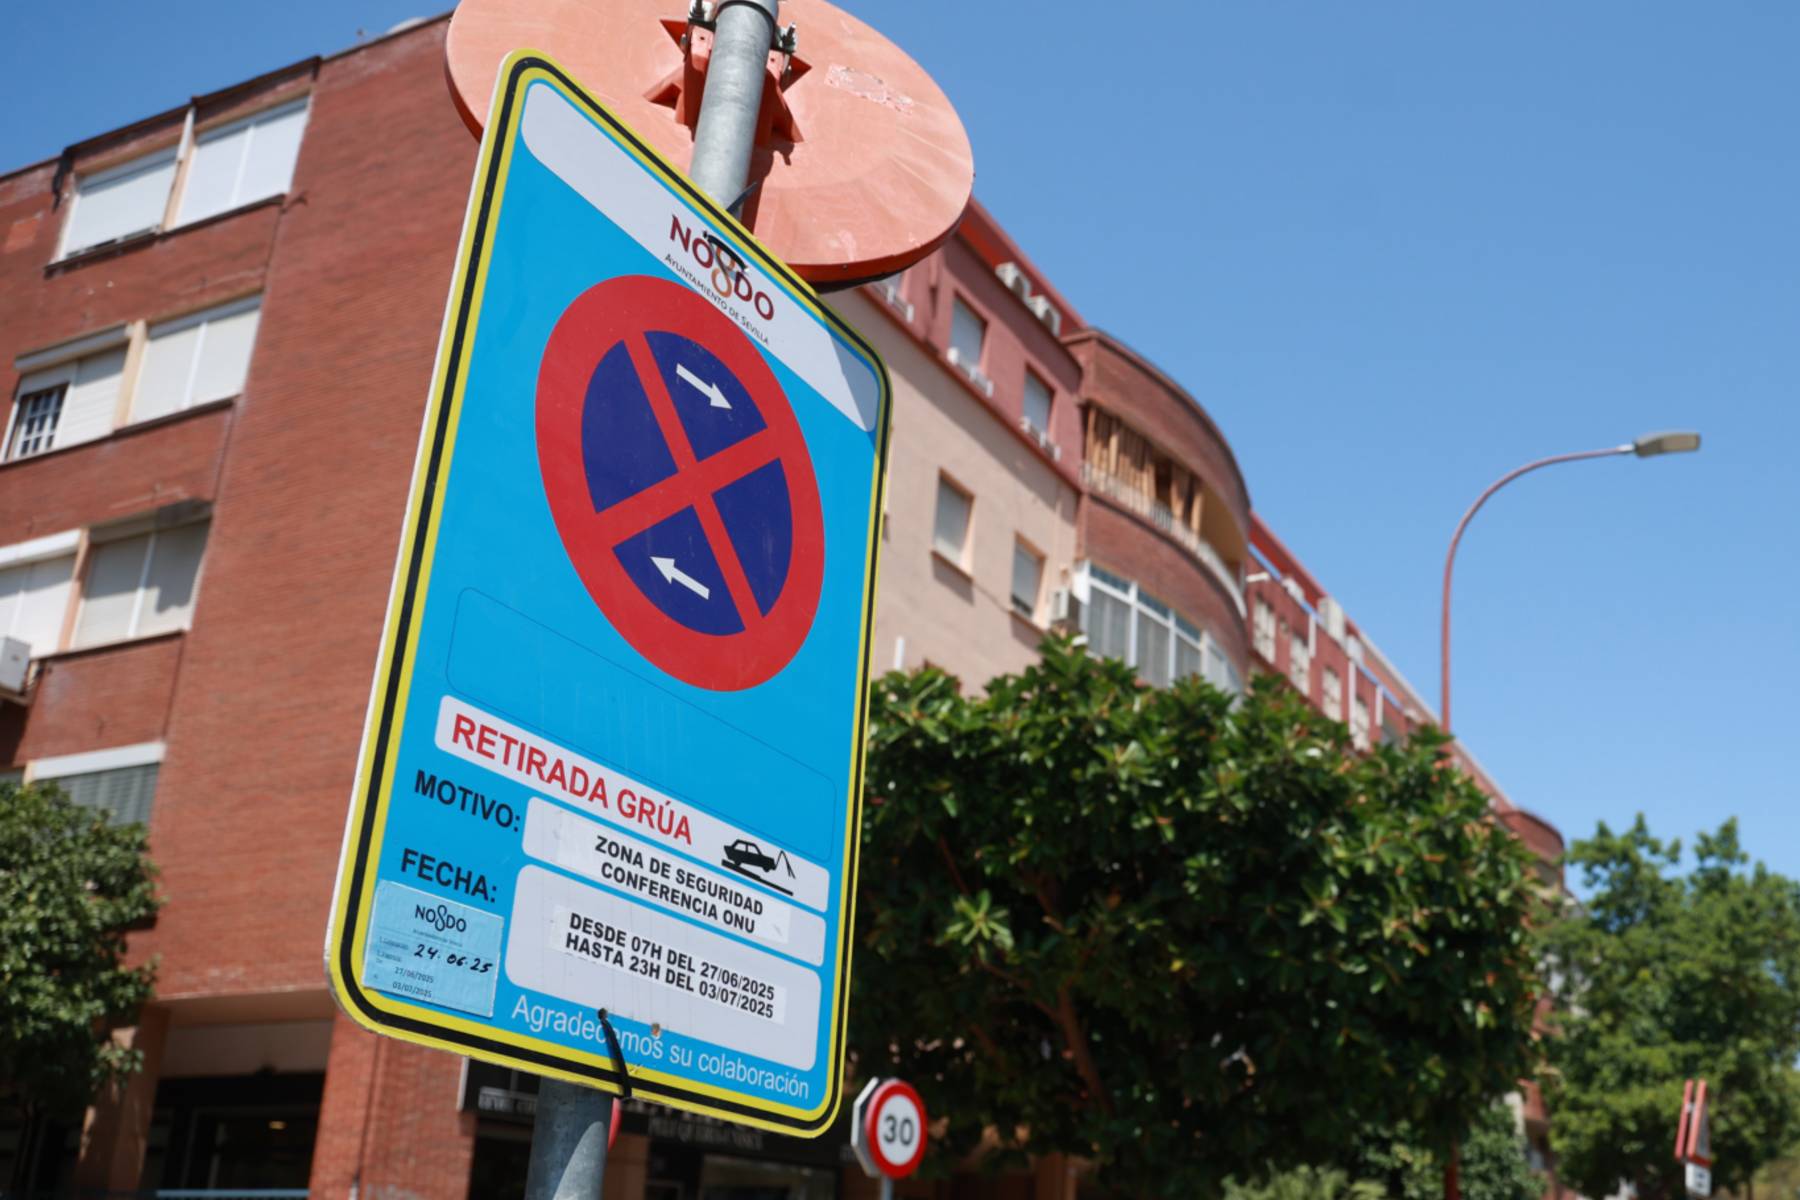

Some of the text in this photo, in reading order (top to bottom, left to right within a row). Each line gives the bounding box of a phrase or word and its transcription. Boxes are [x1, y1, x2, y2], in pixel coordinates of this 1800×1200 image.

[665, 253, 769, 345] AYUNTAMIENTO DE SEVILLA
[415, 769, 520, 832] MOTIVO:
[452, 713, 692, 845] RETIRADA GRÚA
[401, 847, 496, 903] FECHA:
[595, 835, 763, 915] ZONA DE SEGURIDAD
[601, 862, 755, 933] CONFERENCIA ONU
[566, 932, 773, 1019] HASTA 23H DEL 03/07/2025
[569, 913, 774, 1001] DESDE 07H DEL 27/06/2025
[669, 1044, 694, 1067] su
[698, 1052, 809, 1099] colaboración
[884, 1115, 914, 1147] 30
